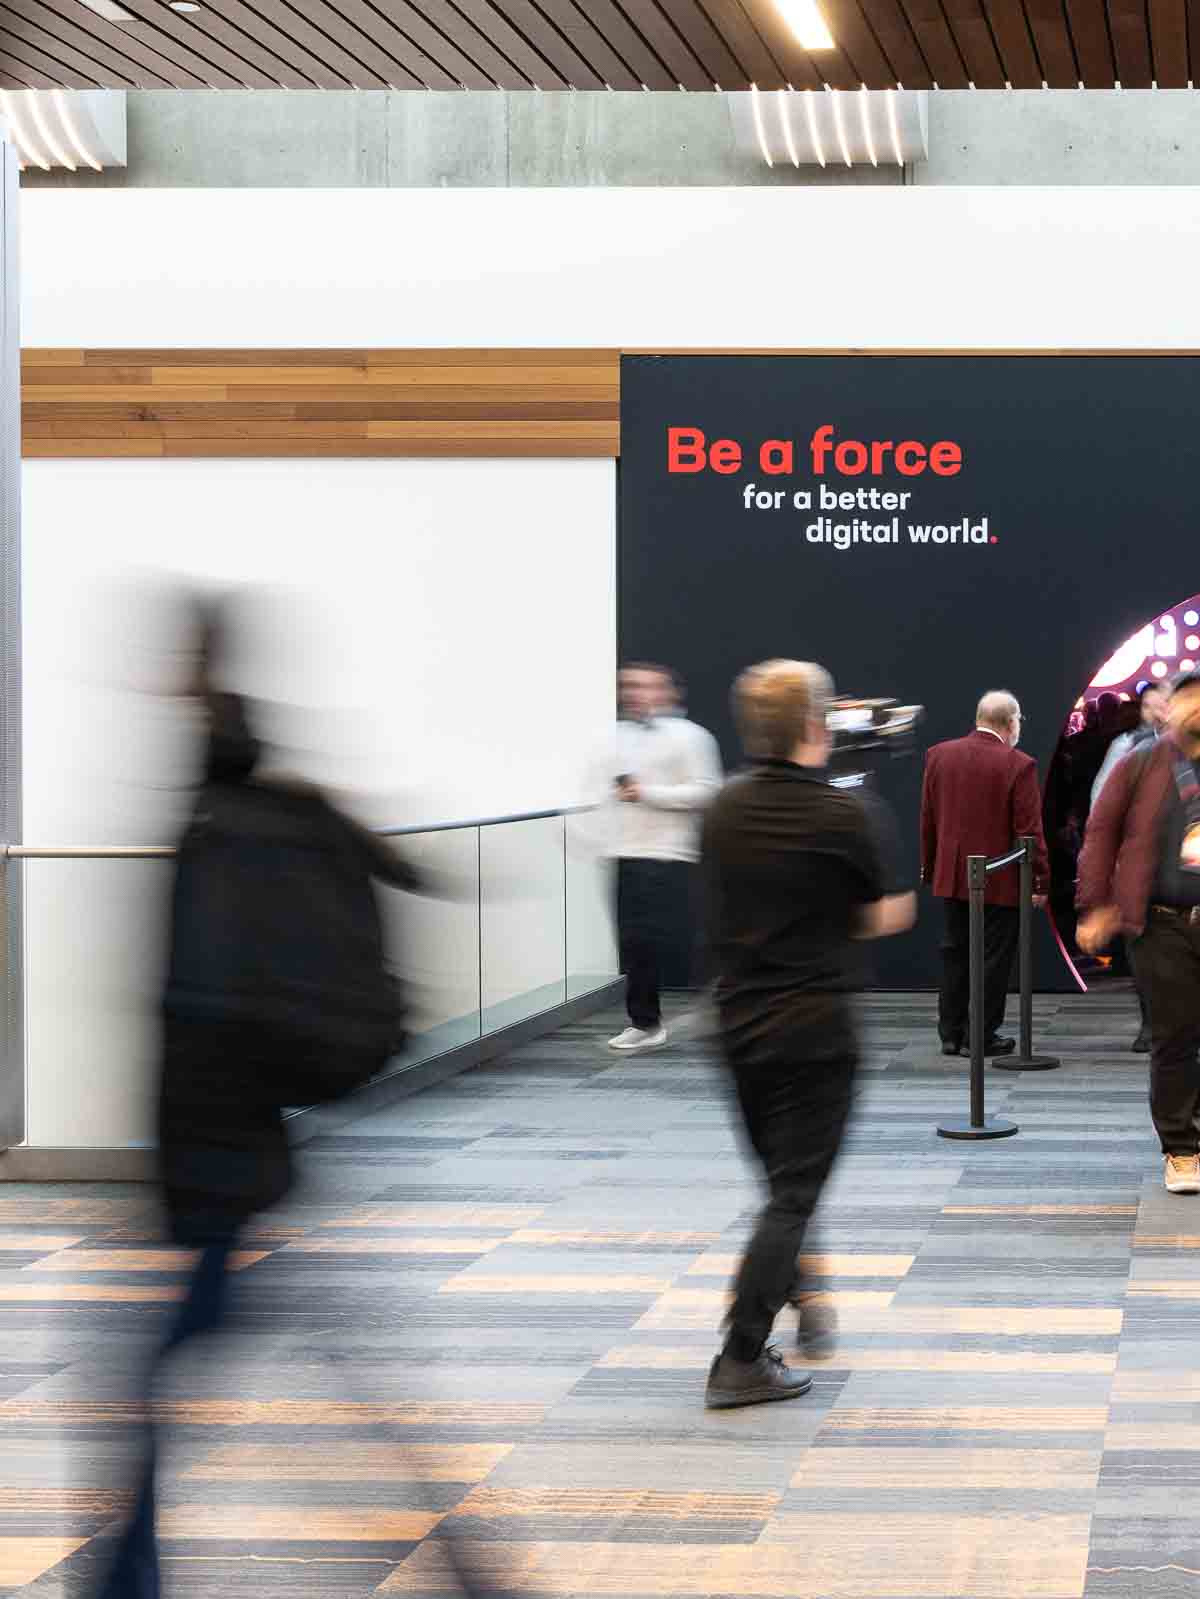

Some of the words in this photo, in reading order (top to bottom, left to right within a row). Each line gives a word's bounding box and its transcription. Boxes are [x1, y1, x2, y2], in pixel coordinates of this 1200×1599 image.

[666, 426, 742, 475] Be
[759, 438, 793, 475] a
[810, 425, 963, 476] force
[743, 483, 786, 510] for
[793, 489, 812, 510] a
[819, 484, 911, 511] better
[805, 517, 899, 549] digital
[908, 518, 998, 543] world.
